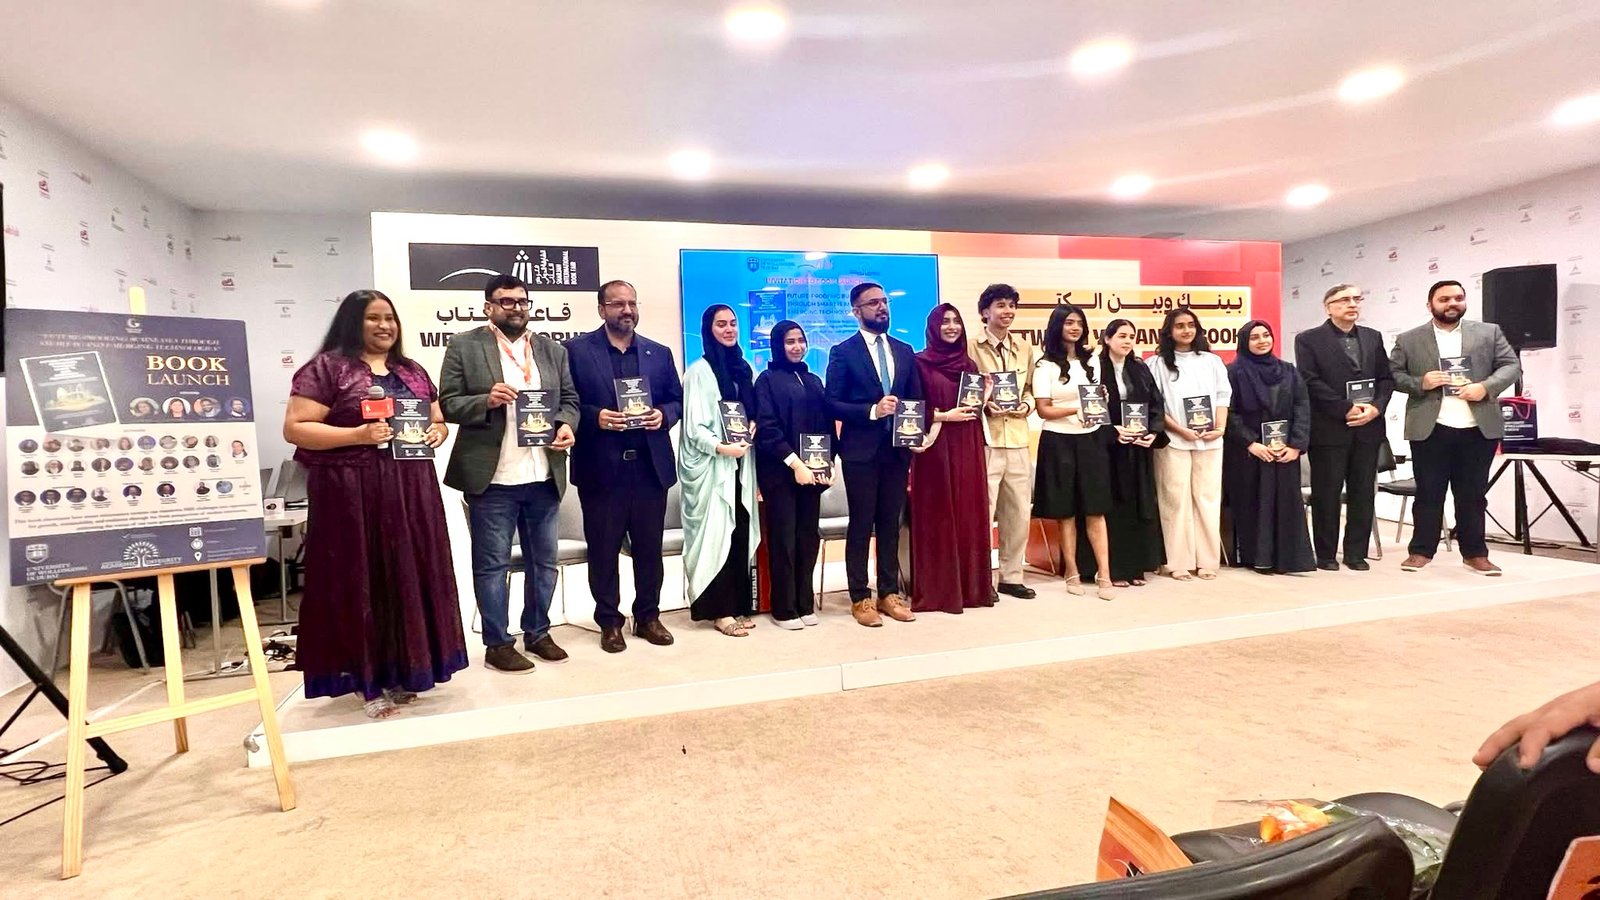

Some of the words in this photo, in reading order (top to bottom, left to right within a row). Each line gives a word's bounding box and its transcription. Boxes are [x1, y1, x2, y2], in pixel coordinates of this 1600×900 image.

[1015, 291, 1102, 309] الكت
[528, 303, 572, 322] قاع
[1136, 329, 1161, 344] AN
[1204, 328, 1239, 344] OO
[146, 355, 228, 372] BOOK
[147, 373, 230, 386] LAUNCH
